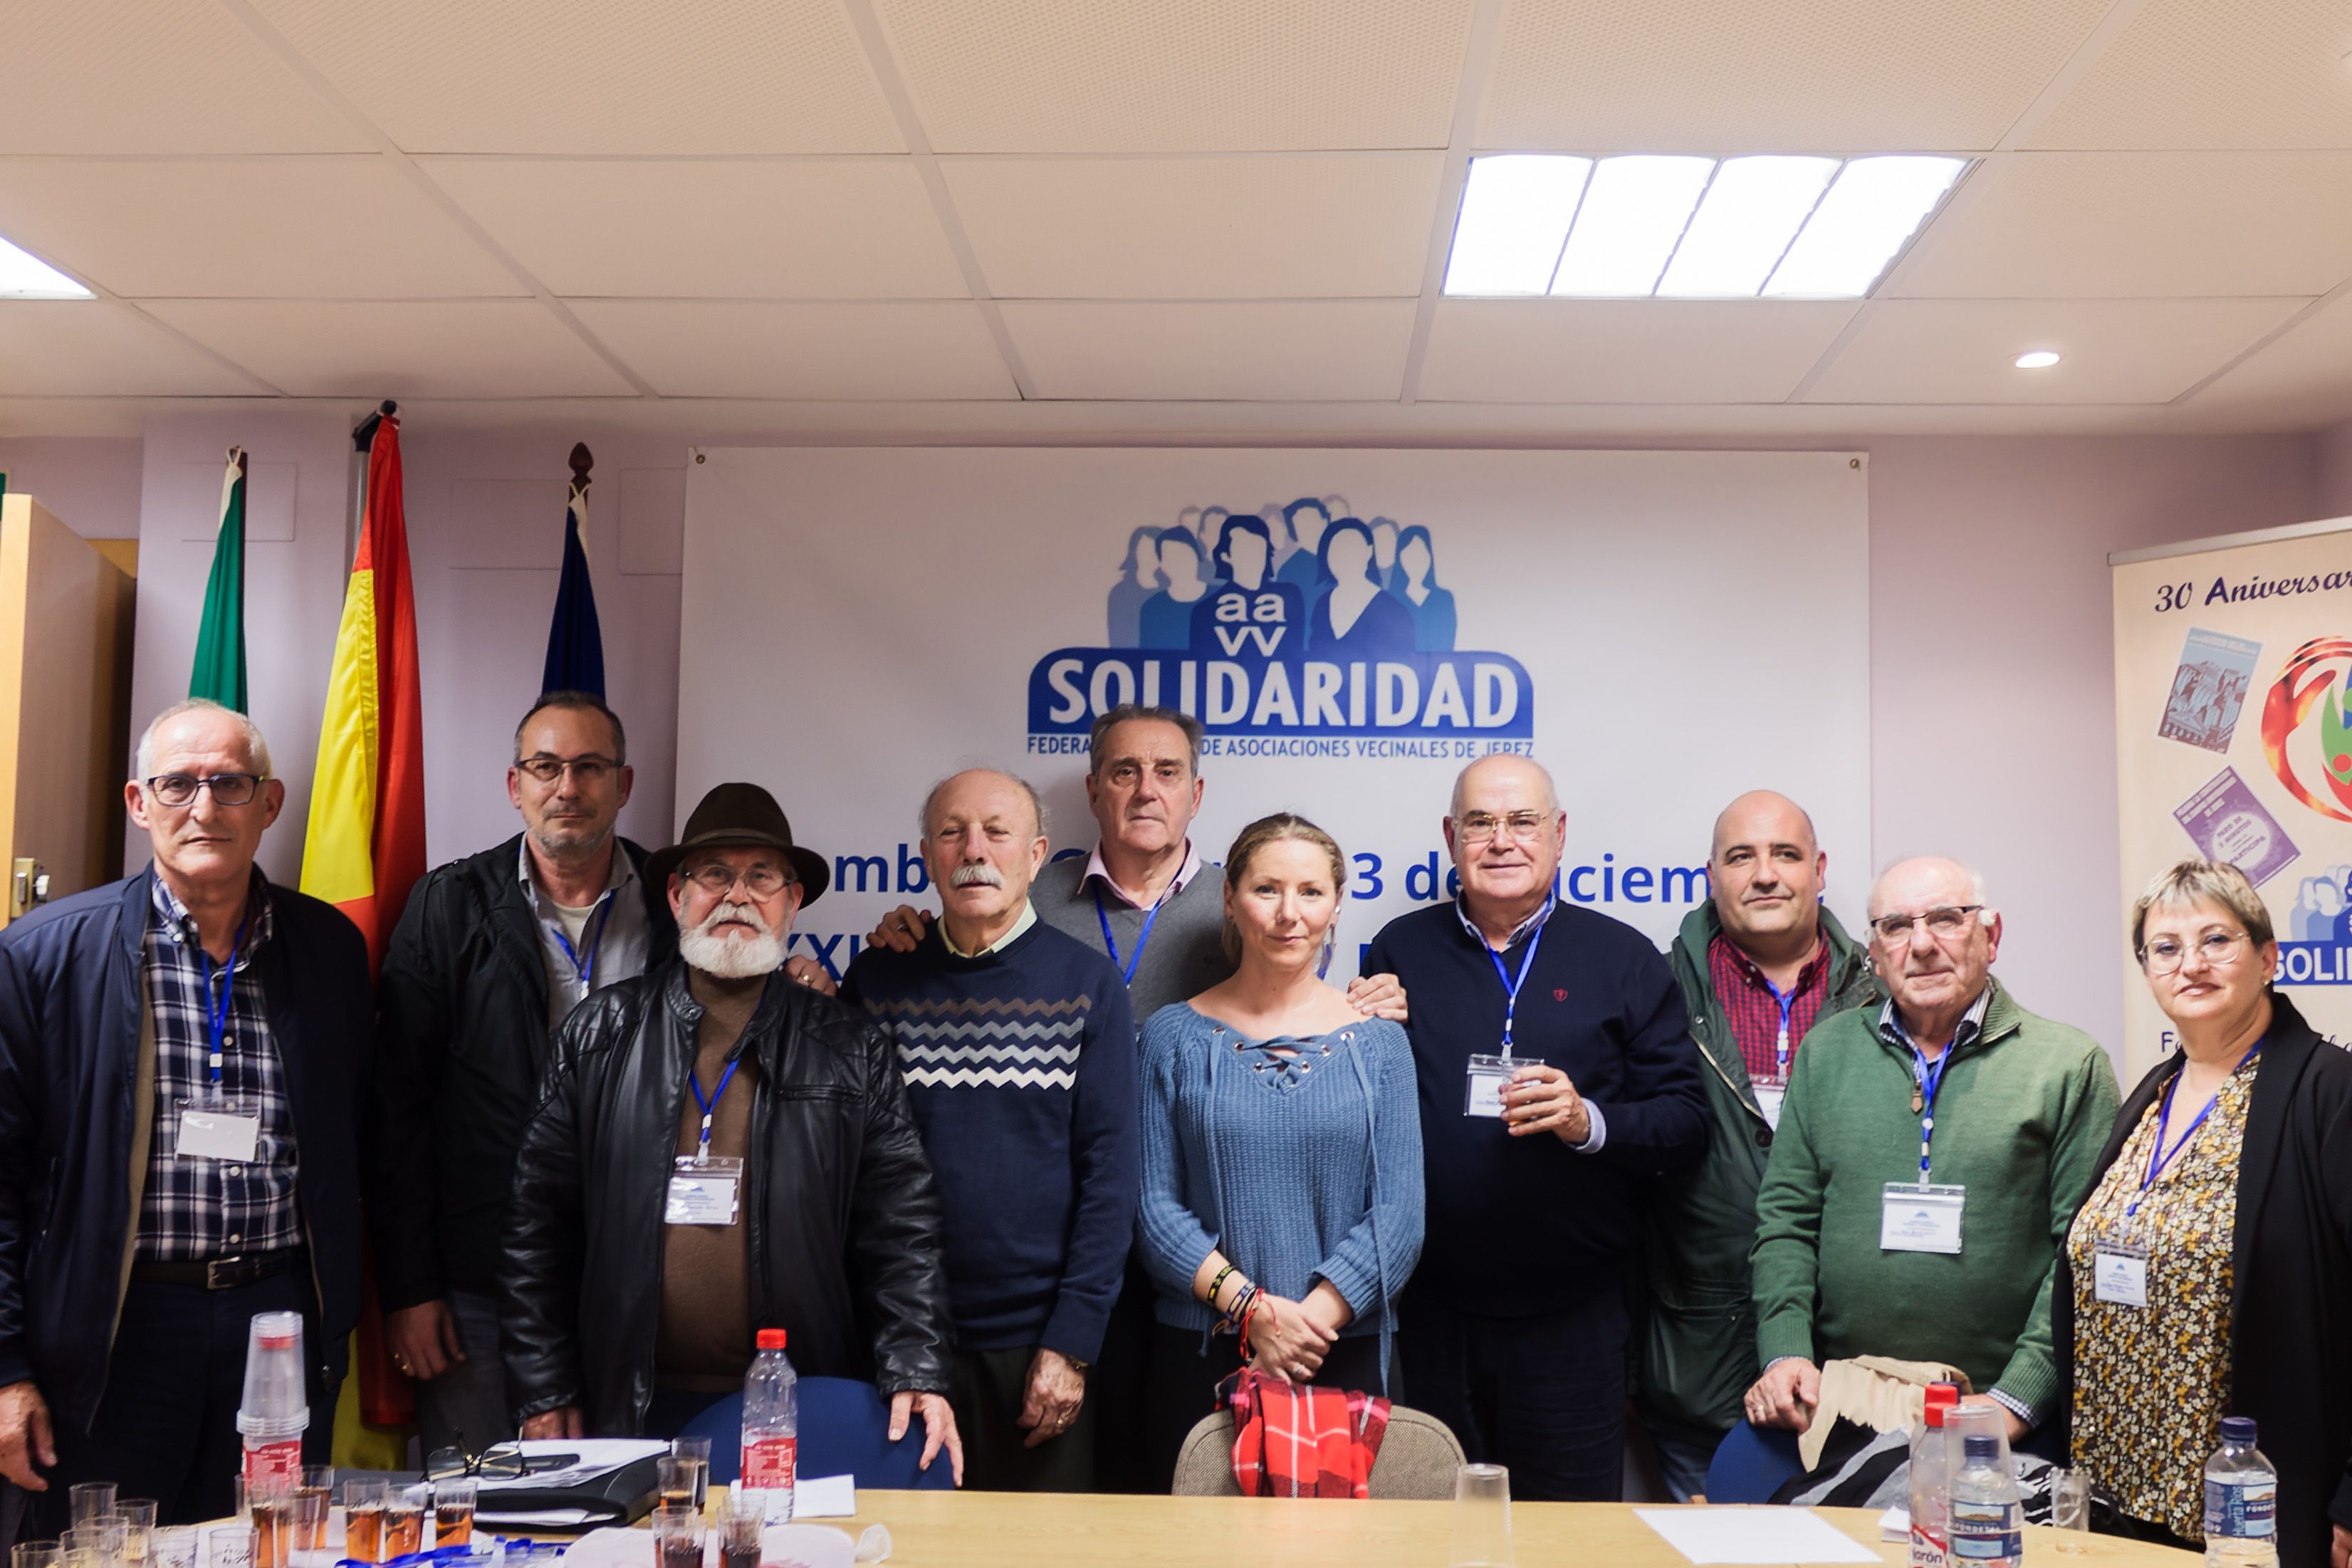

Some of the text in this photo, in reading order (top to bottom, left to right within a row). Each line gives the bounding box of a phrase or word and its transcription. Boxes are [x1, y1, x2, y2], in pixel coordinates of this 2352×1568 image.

[1215, 592, 1287, 623] aa
[2155, 582, 2193, 612] 30
[1047, 659, 1519, 728] SOLIDARIDAD
[1027, 736, 1091, 755] FEDERA
[1201, 738, 1221, 756] DE
[1226, 739, 1350, 757] ASOCIACIONES
[1356, 741, 1448, 758] VECINALES
[1455, 741, 1476, 758] DE
